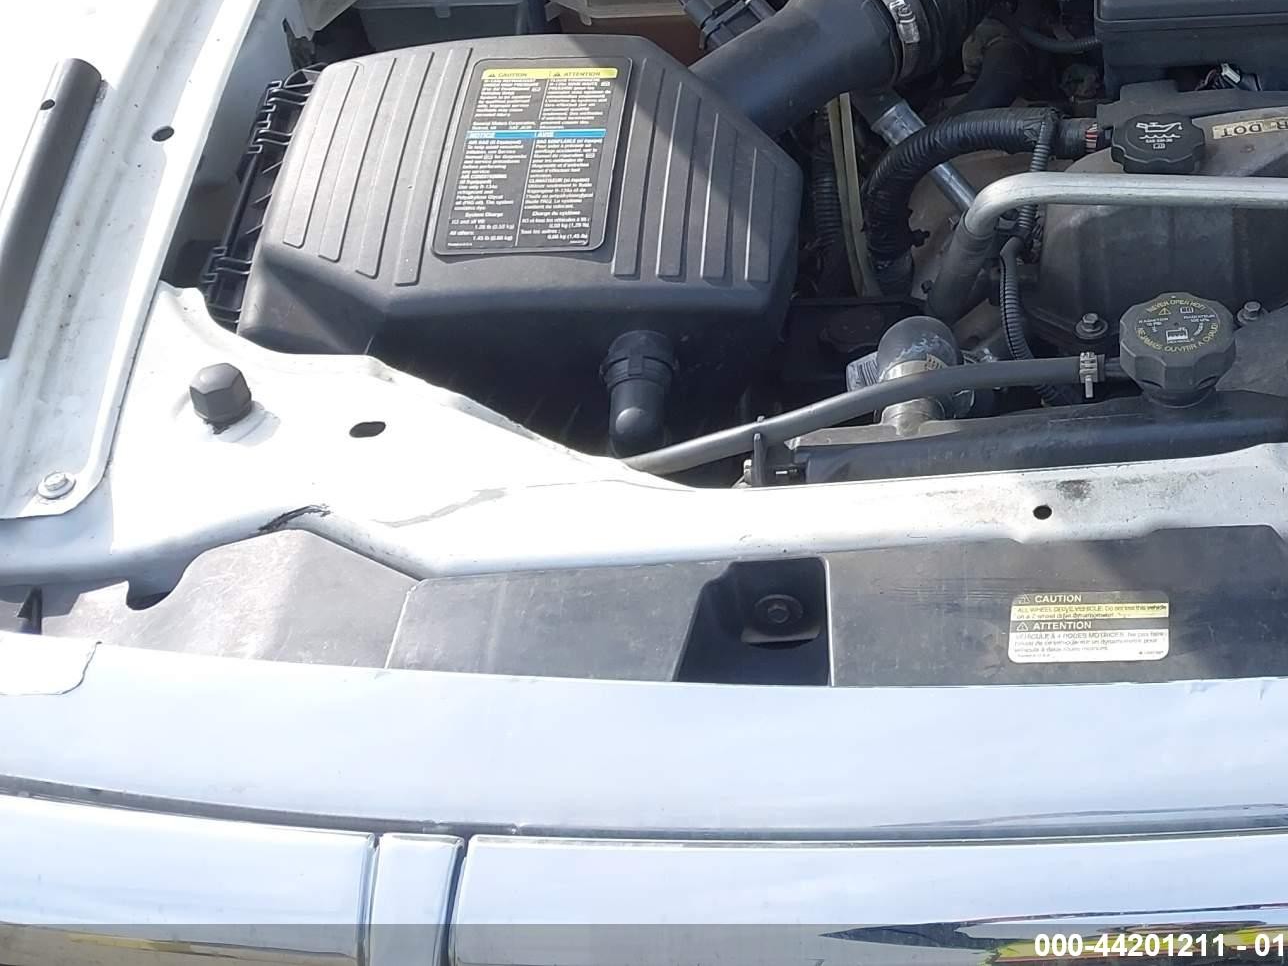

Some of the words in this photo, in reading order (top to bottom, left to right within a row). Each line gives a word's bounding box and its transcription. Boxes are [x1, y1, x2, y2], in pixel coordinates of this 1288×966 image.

[1222, 124, 1262, 138] DOT
[1034, 594, 1082, 603] CAUTION
[1033, 621, 1092, 630] ATTENTION
